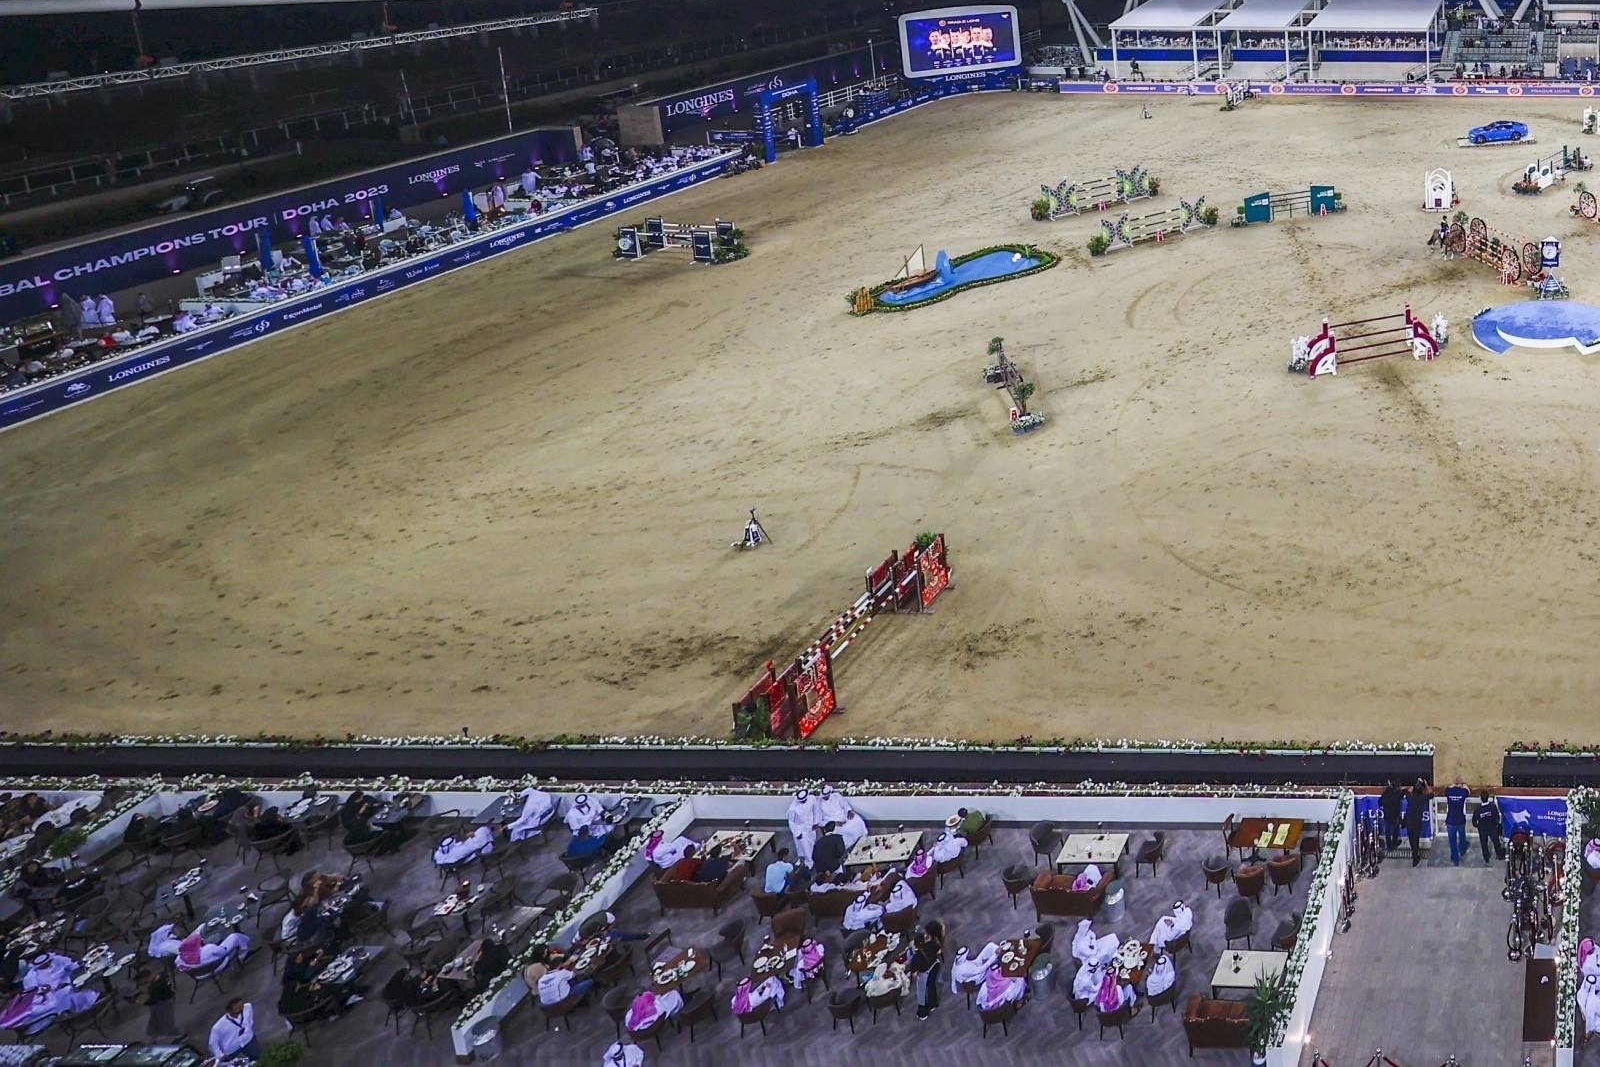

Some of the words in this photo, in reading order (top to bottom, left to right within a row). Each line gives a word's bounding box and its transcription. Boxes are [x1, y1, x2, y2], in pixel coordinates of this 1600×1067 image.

[945, 72, 986, 82] LONGINES
[666, 89, 735, 117] LONGINES
[782, 89, 798, 98] DOHA
[408, 164, 460, 185] LONGINES
[54, 233, 206, 281] CHAMPIONS
[208, 216, 268, 239] TOUR
[282, 197, 339, 221] DOHA
[344, 184, 389, 204] 2023
[489, 232, 525, 249] LONGINES
[108, 355, 170, 382] LONGINES
